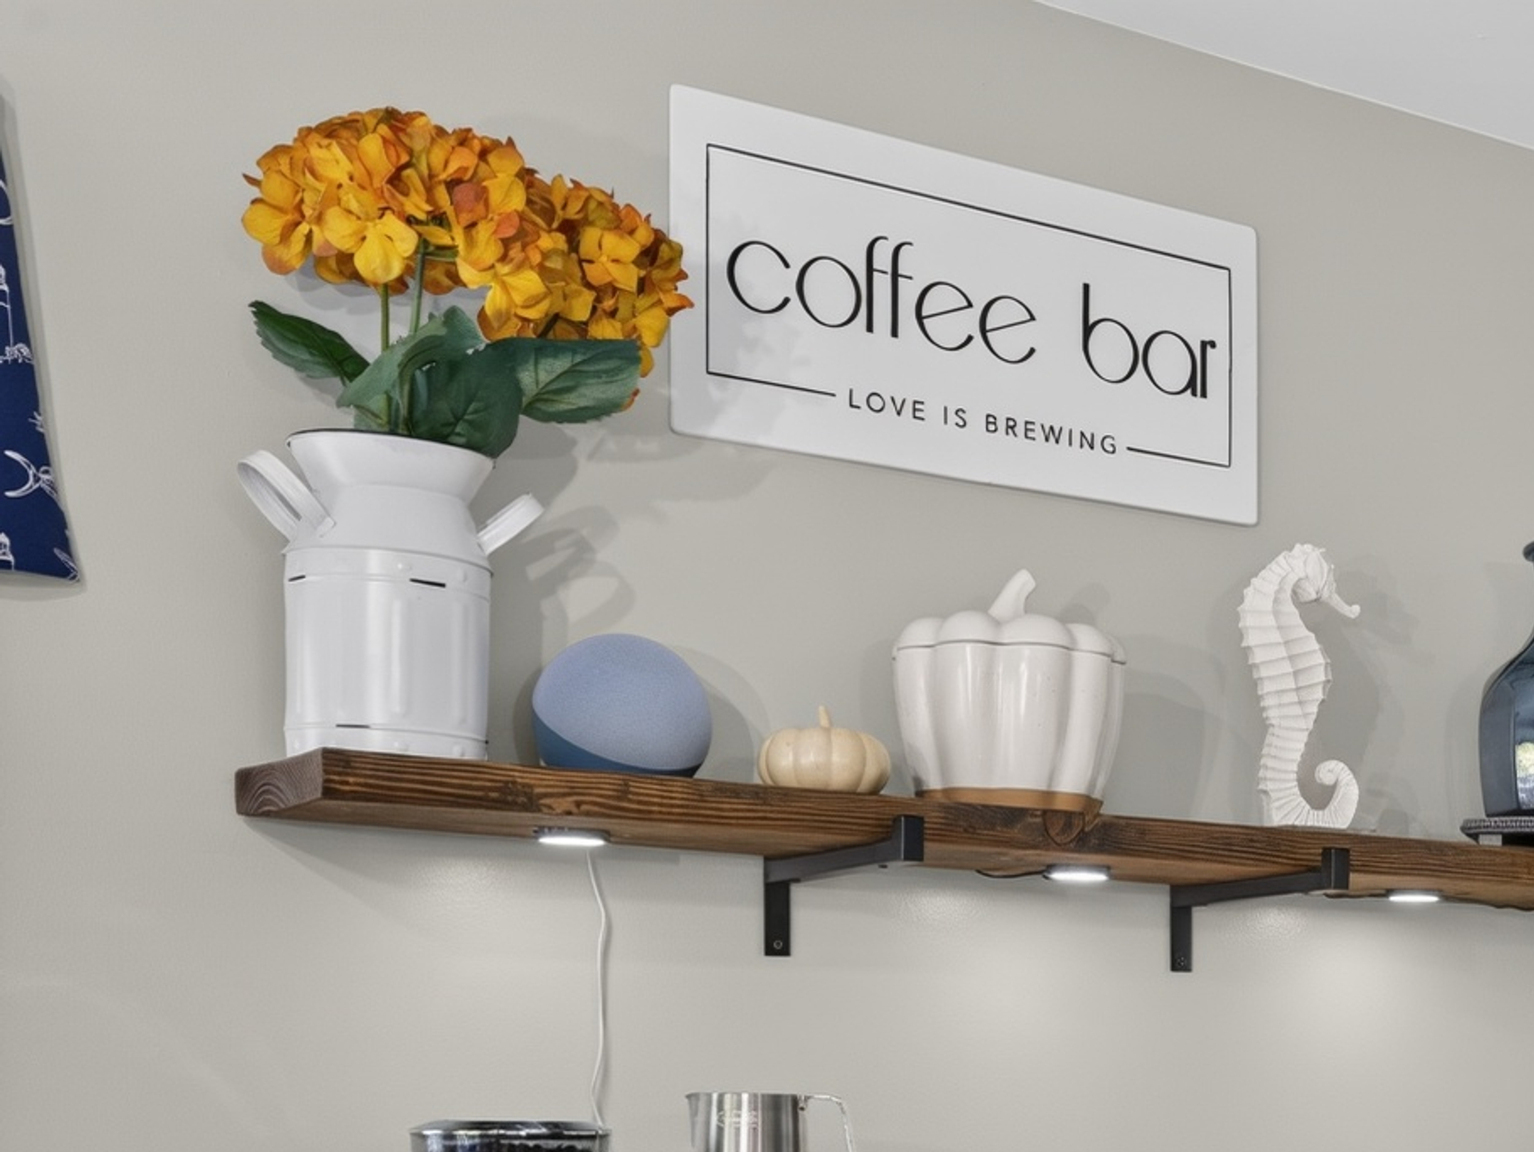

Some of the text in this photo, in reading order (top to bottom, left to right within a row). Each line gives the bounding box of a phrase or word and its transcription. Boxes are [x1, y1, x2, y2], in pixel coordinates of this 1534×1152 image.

[726, 235, 1217, 399] coffee bar
[847, 388, 1119, 456] LOVE IS BREWING
